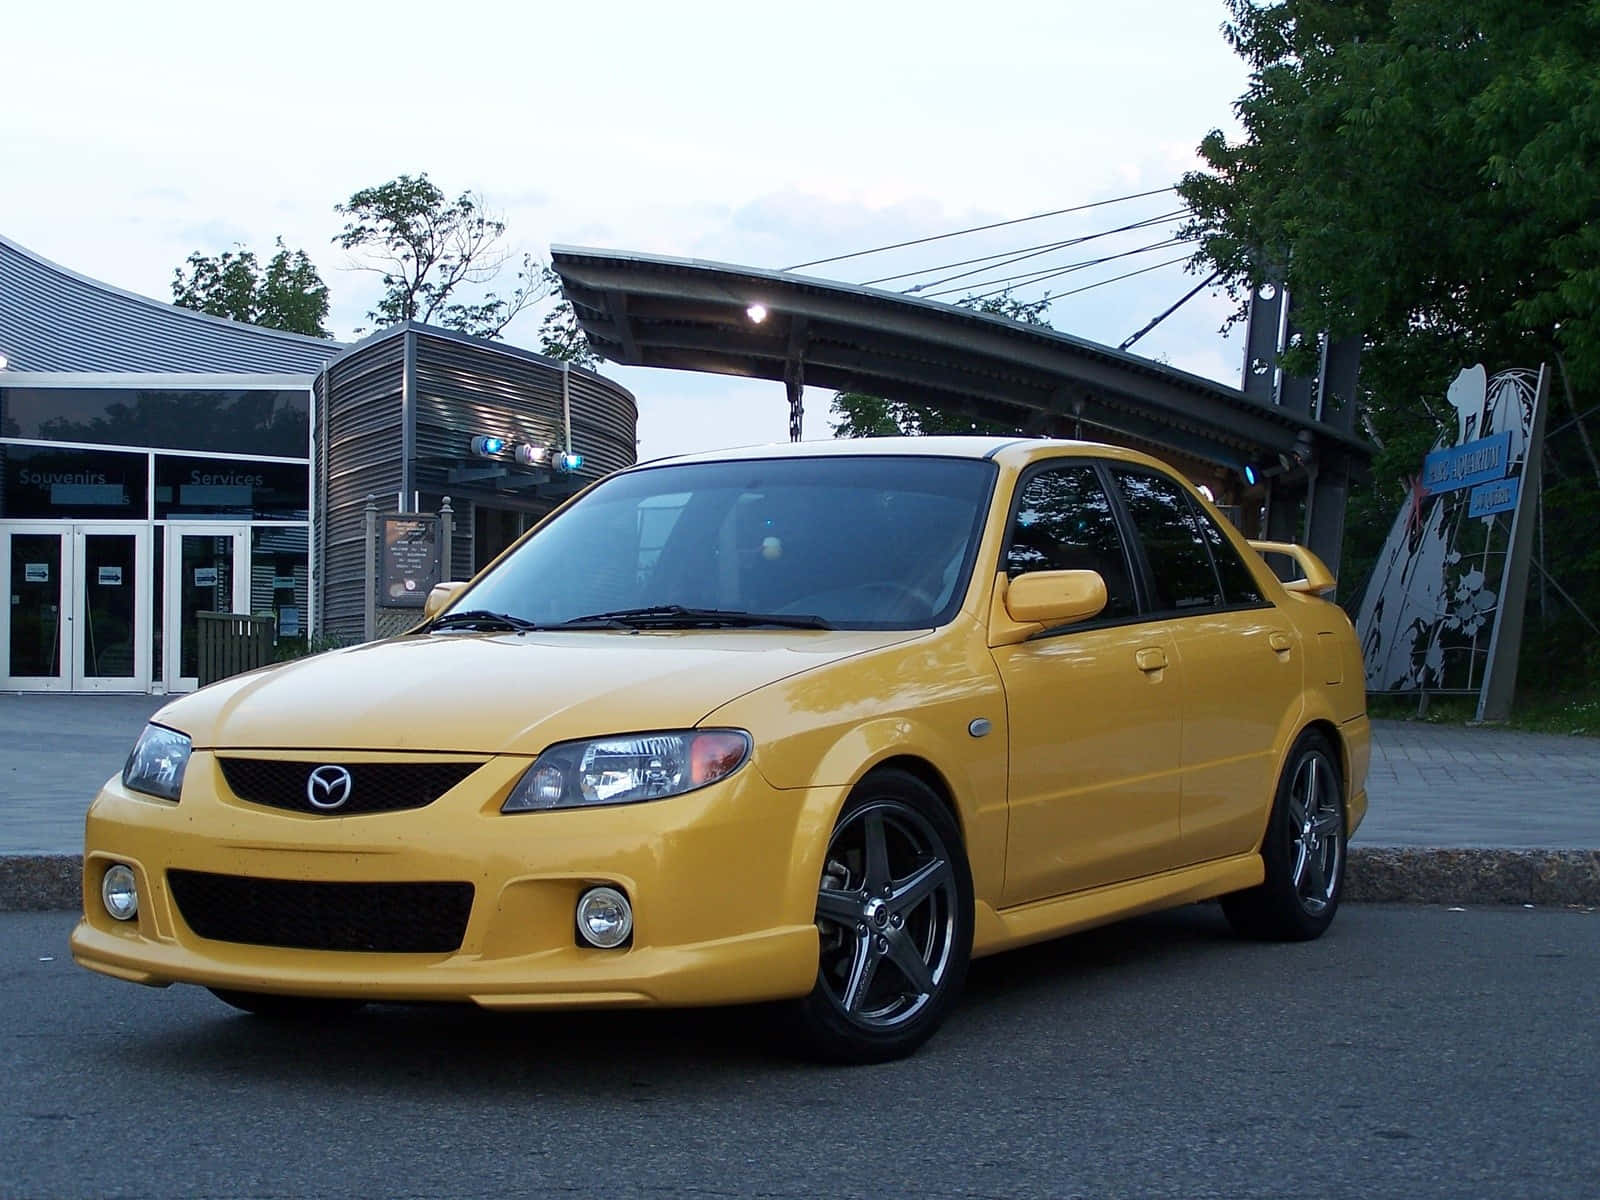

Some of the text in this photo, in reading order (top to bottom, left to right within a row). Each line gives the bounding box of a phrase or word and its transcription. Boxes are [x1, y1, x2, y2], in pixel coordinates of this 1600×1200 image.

[1451, 446, 1502, 480] AQUARIUM
[19, 469, 105, 485] Souvenirs
[191, 470, 264, 485] Services
